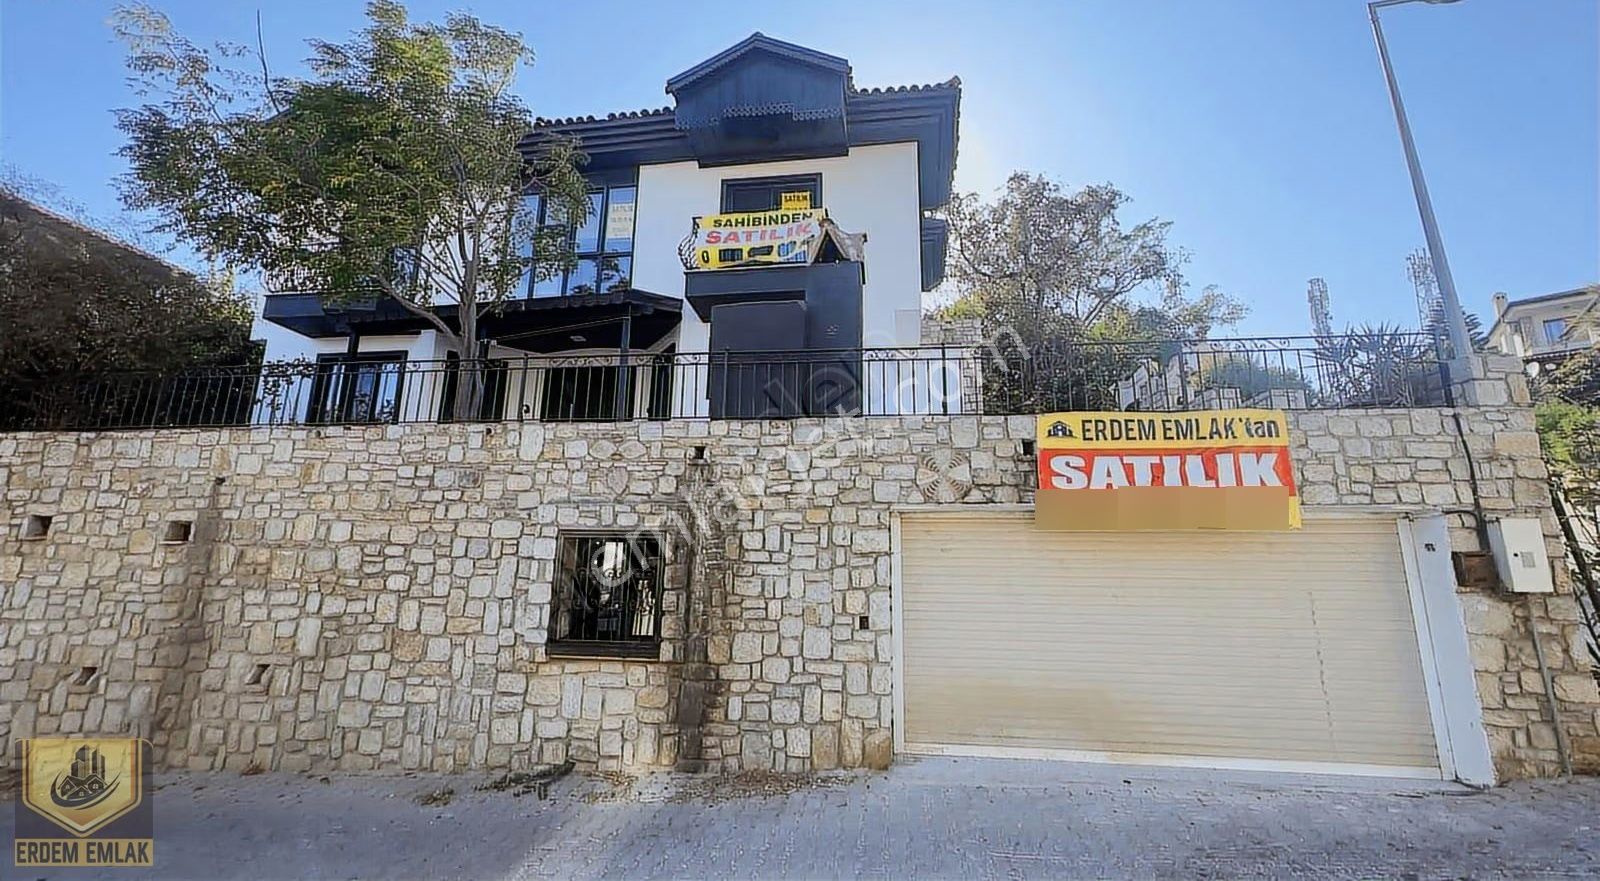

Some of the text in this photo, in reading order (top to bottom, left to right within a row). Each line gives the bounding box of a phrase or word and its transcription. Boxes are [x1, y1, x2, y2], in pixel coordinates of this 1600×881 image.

[713, 212, 813, 228] SAHİBİNDEN
[705, 222, 813, 244] SATILIK
[1081, 418, 1157, 441] ERDEM
[1050, 453, 1283, 490] SATILIK
